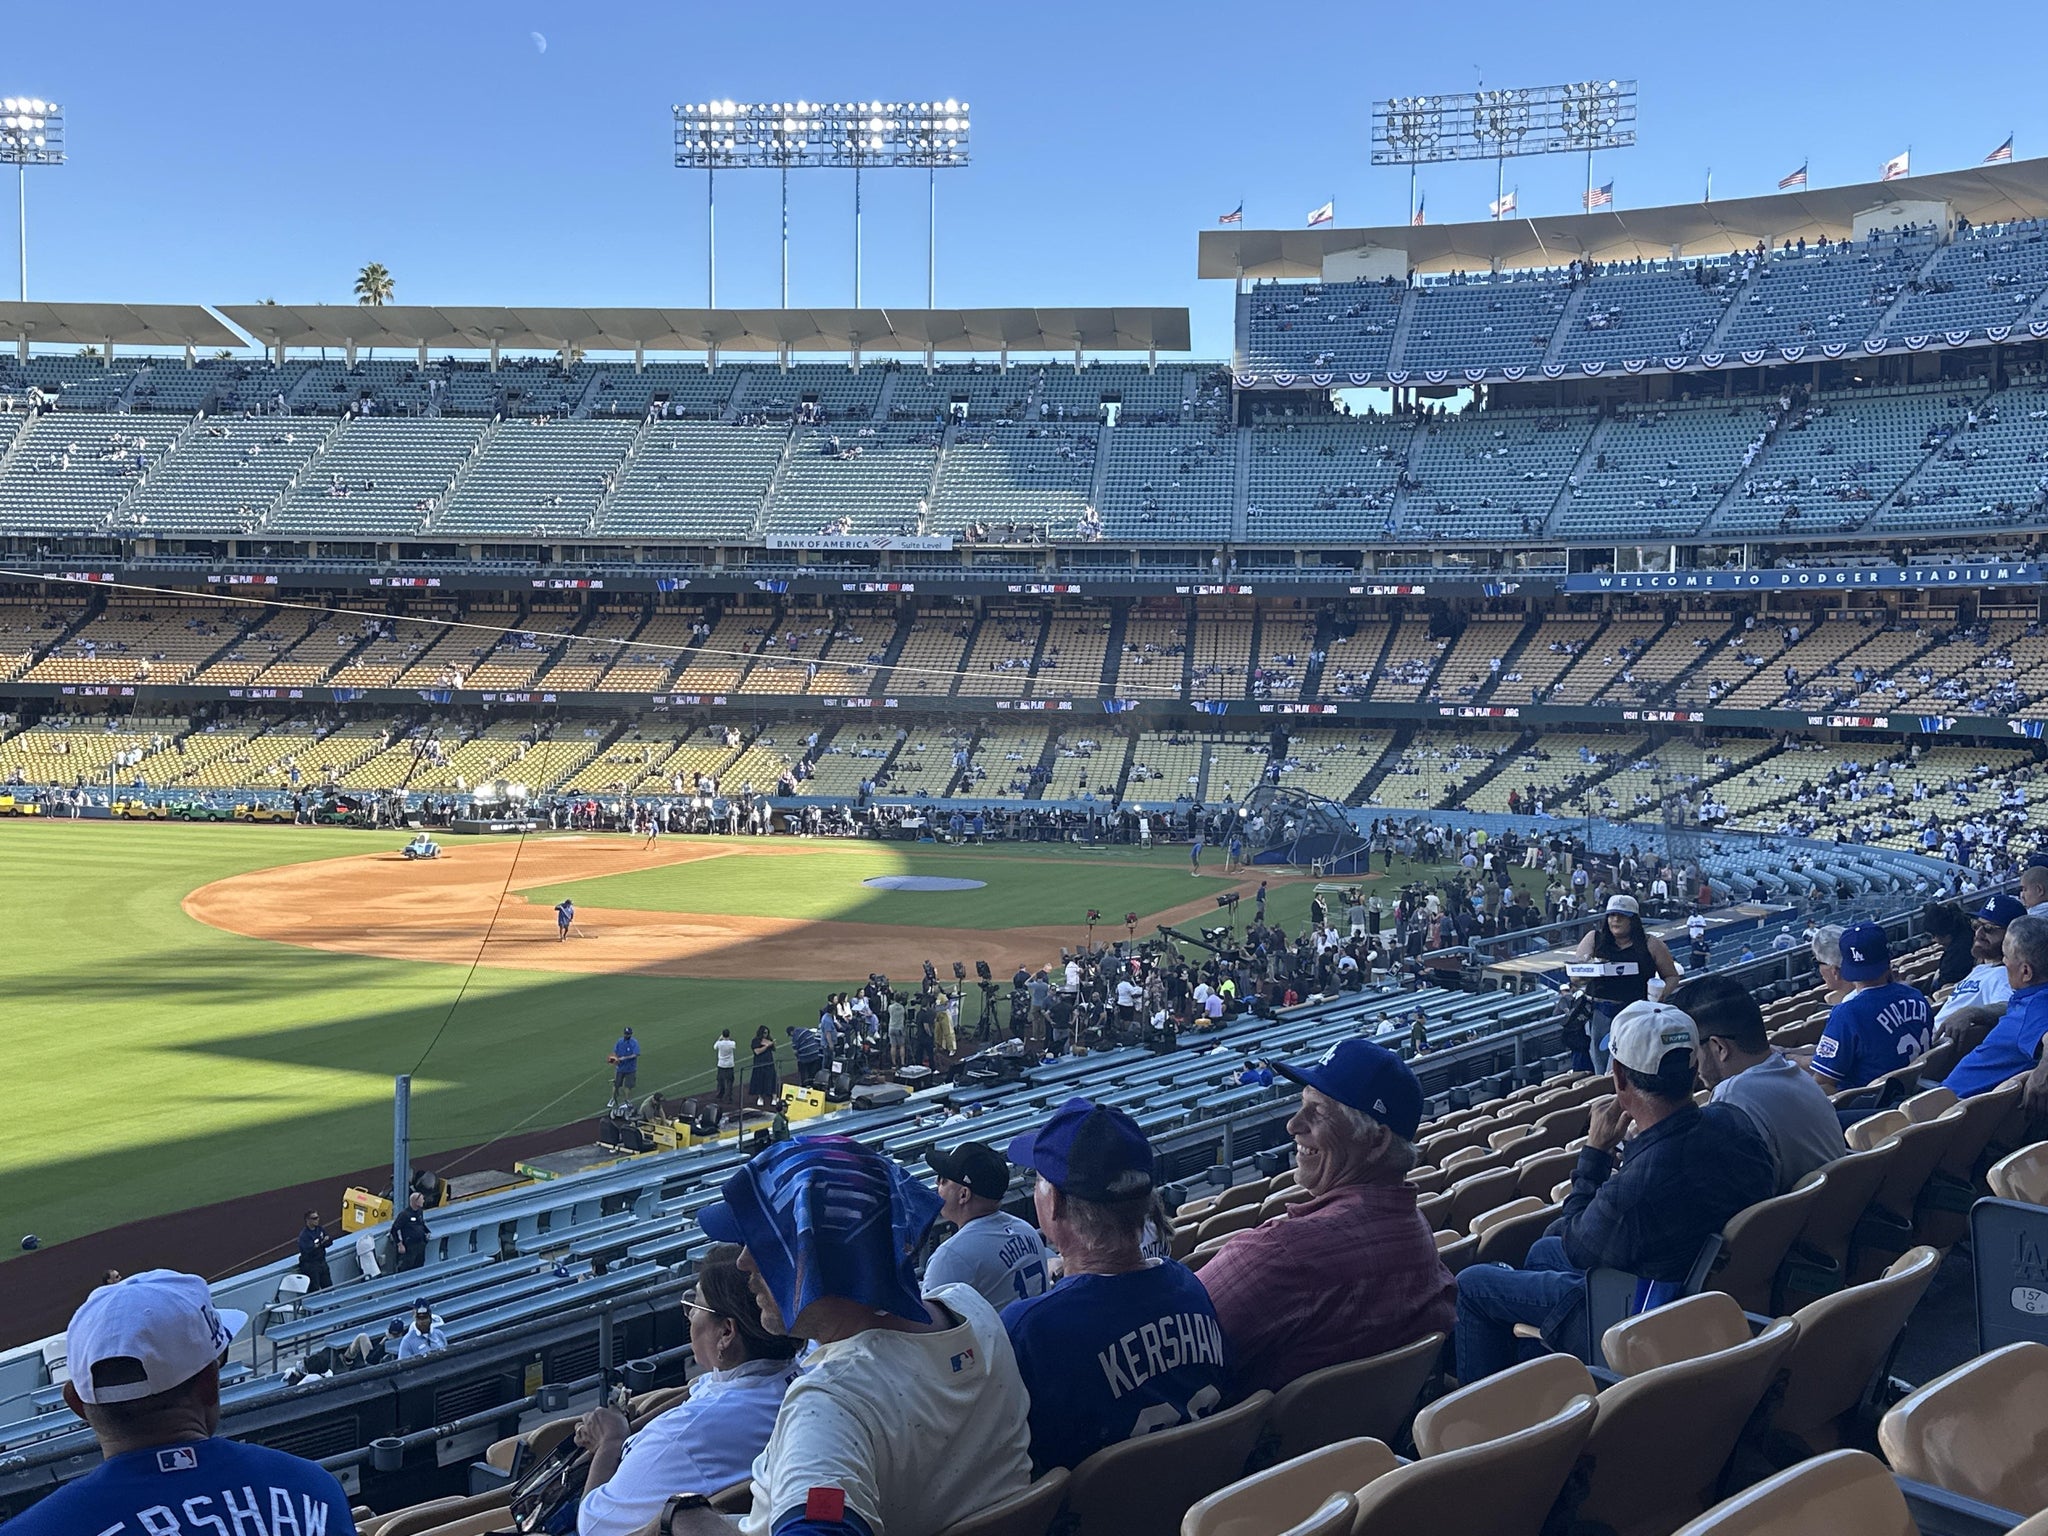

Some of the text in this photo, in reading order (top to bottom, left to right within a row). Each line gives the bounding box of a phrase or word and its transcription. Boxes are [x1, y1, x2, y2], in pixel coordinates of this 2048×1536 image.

[777, 540, 806, 548] BANK
[823, 541, 870, 549] AMERICA
[901, 541, 920, 549] Suite
[1600, 568, 2009, 587] WELCOME TO DODGER STADIUM
[1176, 586, 1190, 594] VISIT
[1259, 704, 1274, 712] VISIT
[1440, 708, 1455, 716] VISIT
[1623, 712, 1638, 720] VISIT
[1808, 716, 1823, 725] VISIT
[1850, 947, 1865, 961] LA
[1876, 999, 1927, 1034] PIAZZA
[1000, 1234, 1039, 1269] OHTANI
[1013, 1260, 1047, 1300] 17
[2021, 1289, 2041, 1301] 157
[2025, 1301, 2035, 1311] G
[1098, 1313, 1223, 1399] KERSHAW
